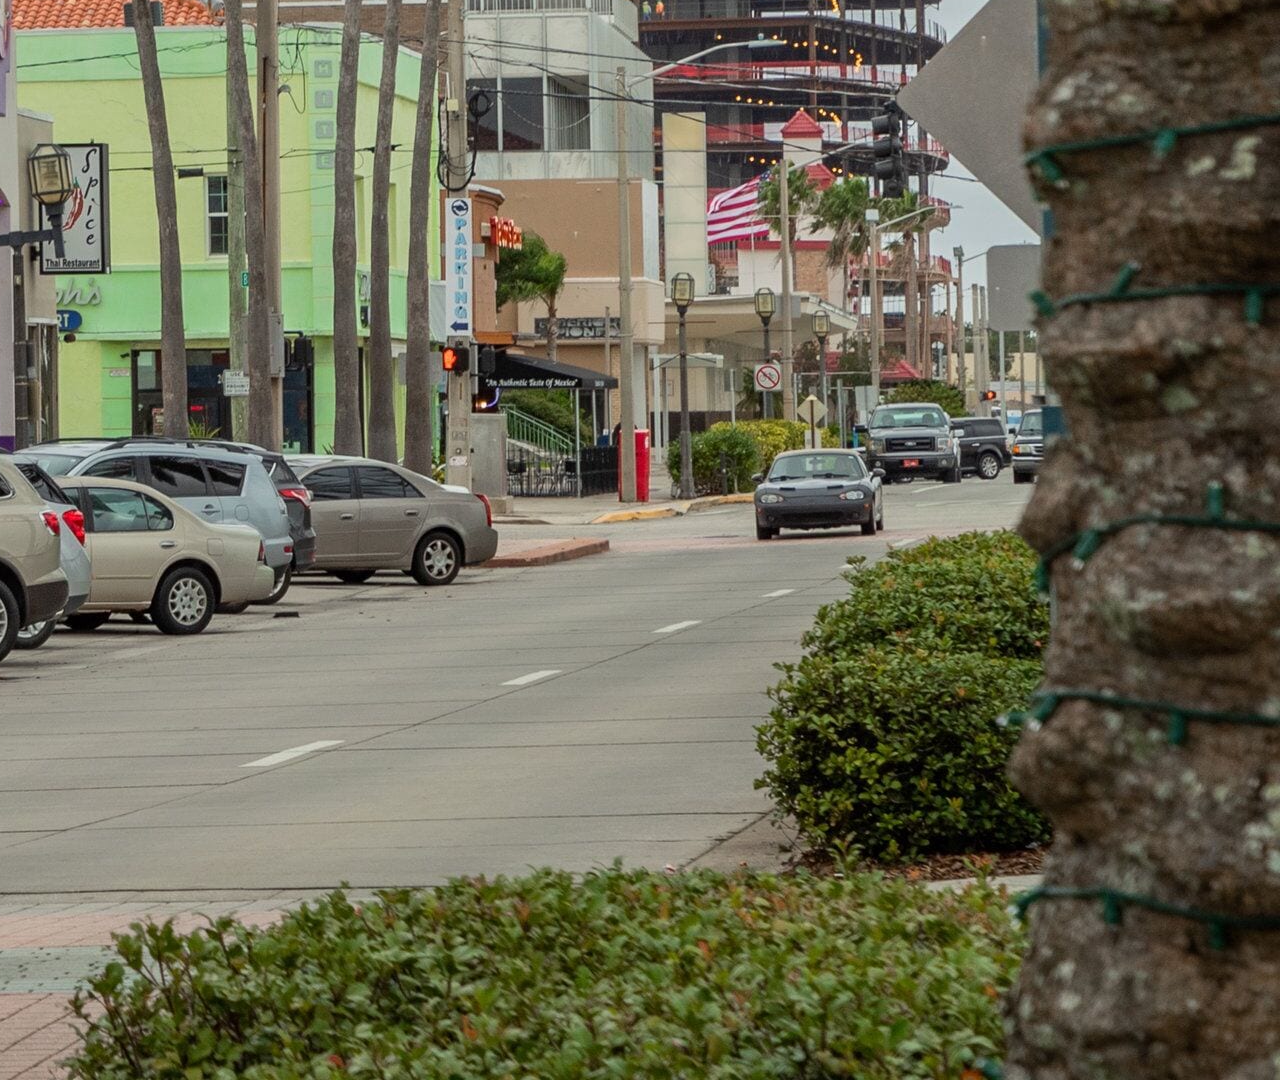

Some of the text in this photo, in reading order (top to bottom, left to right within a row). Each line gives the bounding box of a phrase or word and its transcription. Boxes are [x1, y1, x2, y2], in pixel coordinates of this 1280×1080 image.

[81, 148, 100, 245] Spice
[45, 258, 100, 268] Thai Restaurant
[454, 218, 468, 319] PARKING
[498, 378, 528, 387] Authentic
[529, 378, 544, 387] Taste
[545, 379, 553, 389] Of
